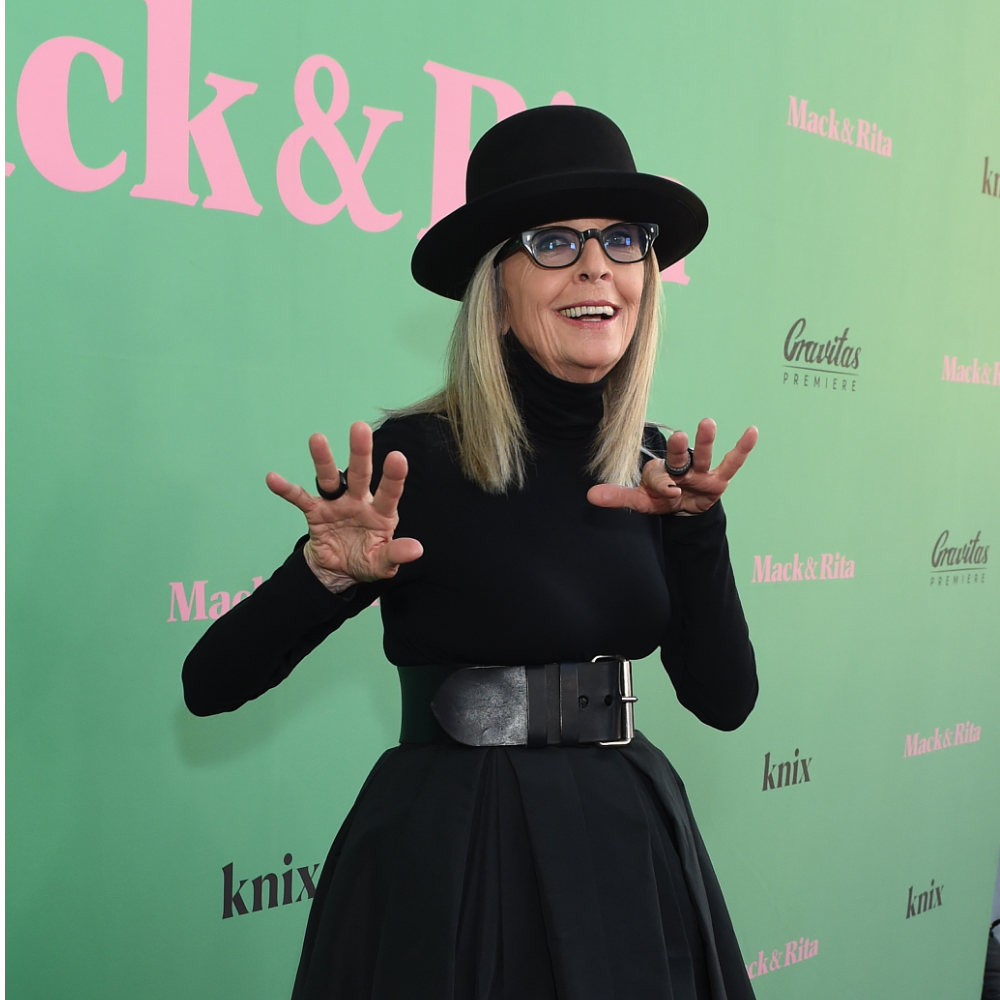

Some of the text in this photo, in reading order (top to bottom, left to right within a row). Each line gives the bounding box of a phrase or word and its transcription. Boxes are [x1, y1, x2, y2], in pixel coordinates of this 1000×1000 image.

[784, 318, 861, 369] Gravitas
[783, 372, 856, 392] PREMIERE
[931, 530, 989, 567] Gravitas
[930, 573, 986, 587] PREMIERE
[762, 748, 812, 792] knix
[222, 853, 321, 920] knix
[906, 879, 944, 919] knix
[745, 937, 819, 980] ck&Rita
